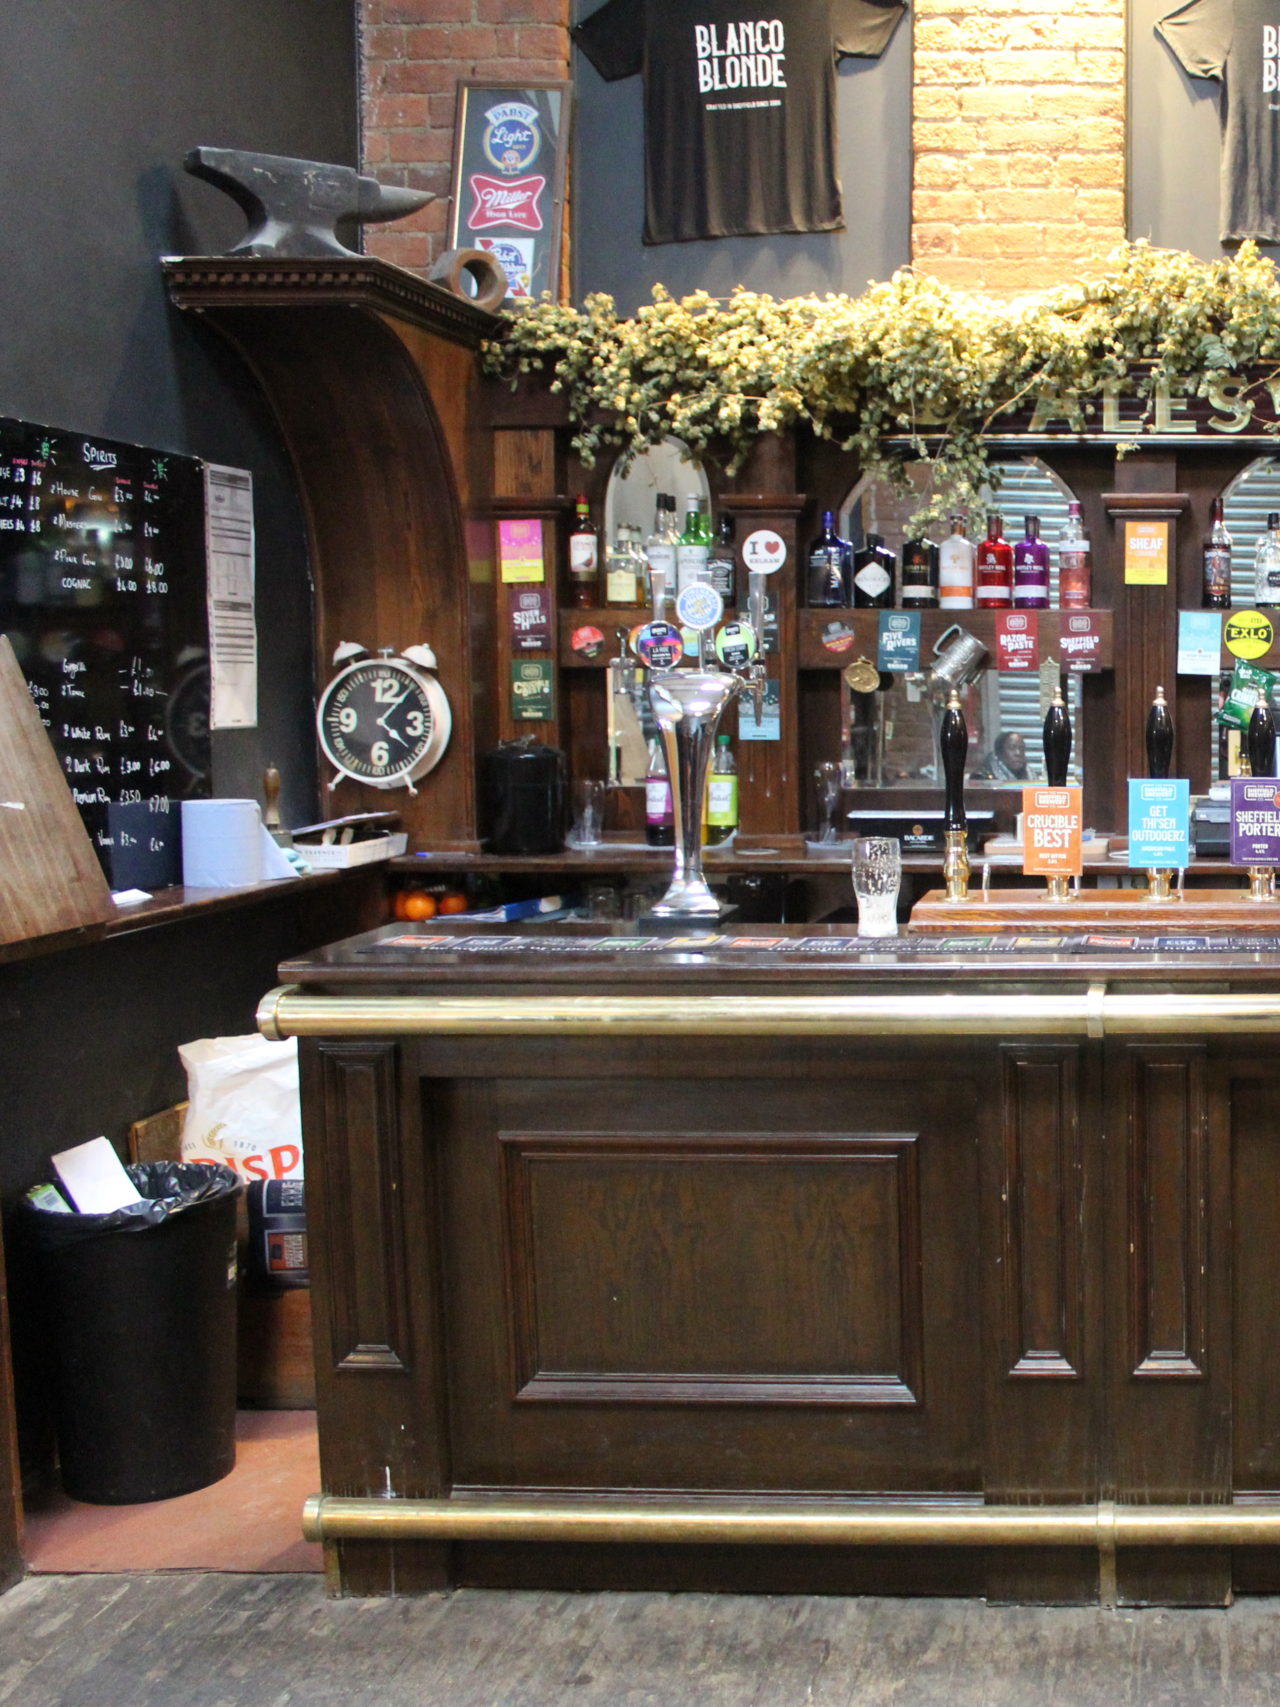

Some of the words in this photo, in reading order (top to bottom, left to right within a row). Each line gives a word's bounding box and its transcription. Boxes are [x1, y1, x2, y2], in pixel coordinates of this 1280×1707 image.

[694, 19, 785, 58] BLANCO
[698, 53, 788, 93] BLONDE
[492, 107, 531, 121] PABST
[491, 127, 532, 149] Light
[481, 188, 532, 208] Miller
[83, 442, 117, 465] SPIRITS
[1129, 537, 1164, 550] SHEAF
[62, 578, 91, 590] COGNAC
[371, 678, 402, 703] 12
[339, 708, 357, 733] 9
[405, 711, 425, 737] 3
[371, 741, 390, 766] 6
[1027, 814, 1079, 829] CRUCIBLE
[1149, 805, 1169, 817] GET
[1034, 829, 1072, 848] BEST
